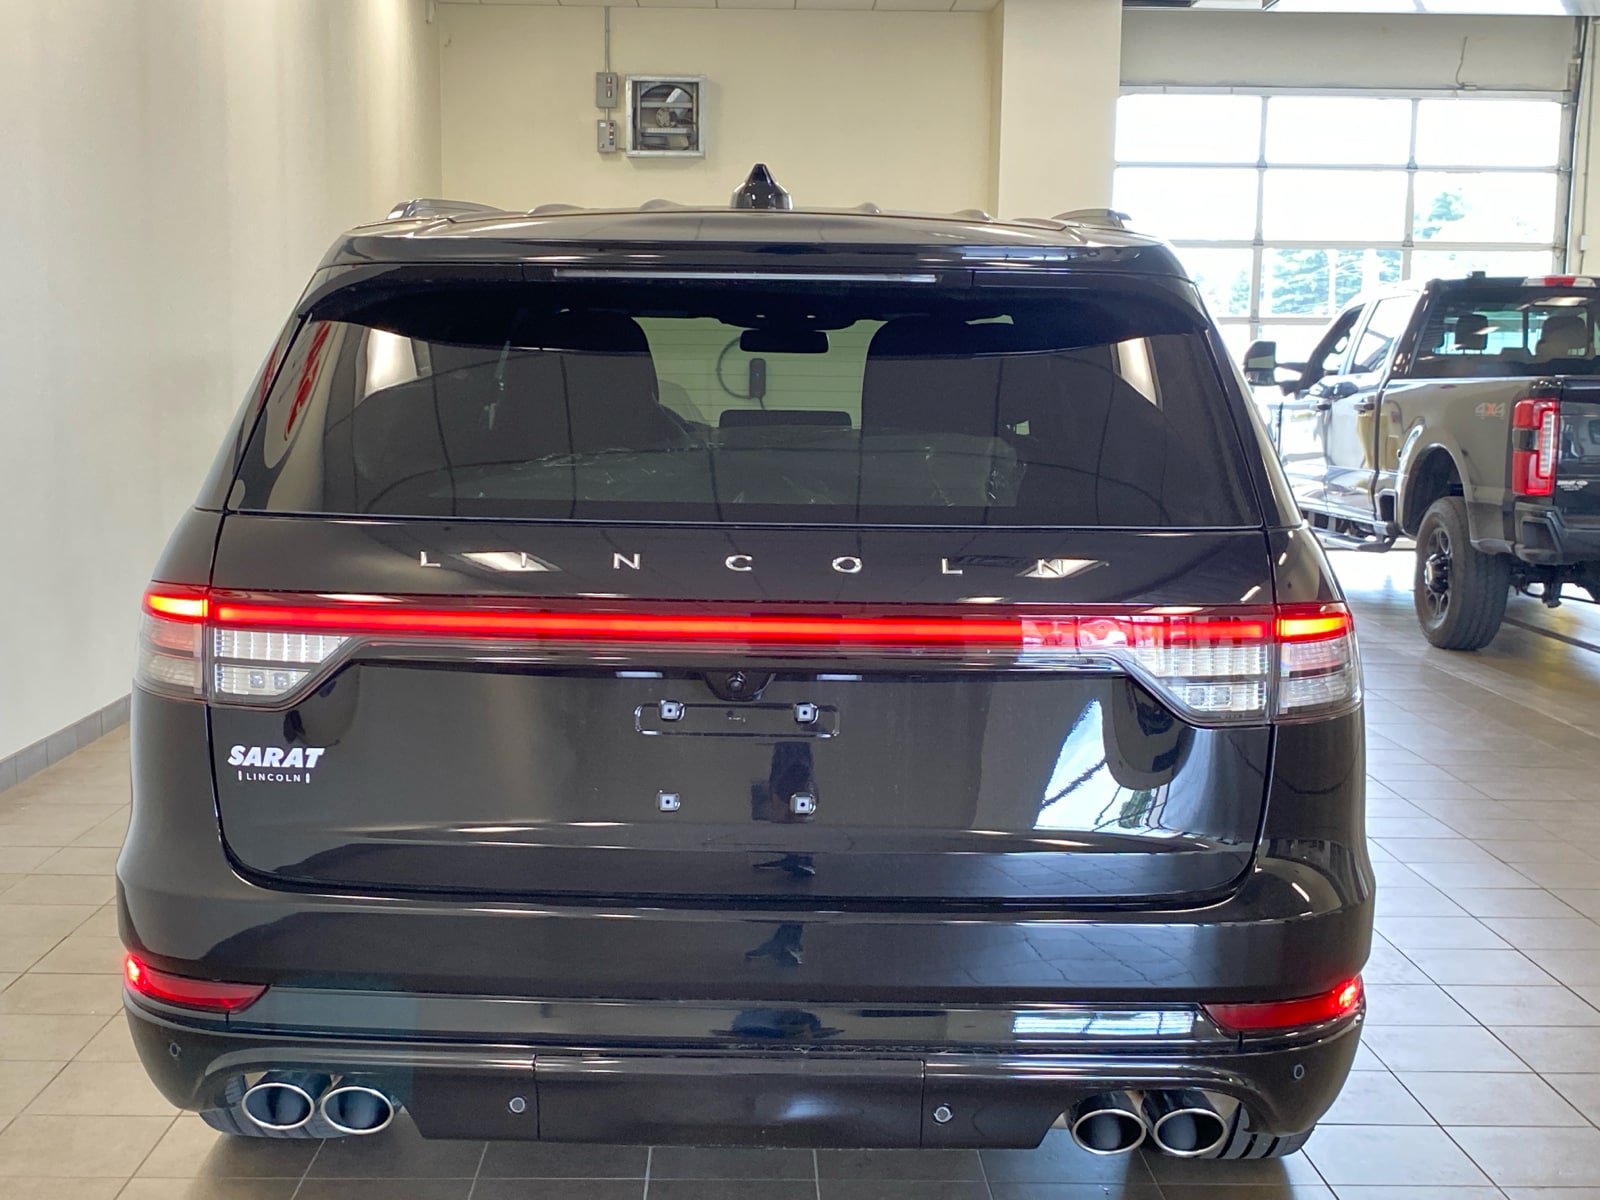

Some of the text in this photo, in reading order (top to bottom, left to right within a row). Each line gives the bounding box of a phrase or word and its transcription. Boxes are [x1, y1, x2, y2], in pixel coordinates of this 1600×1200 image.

[419, 551, 1065, 576] LINCOLN
[227, 745, 325, 768] SARAT
[246, 772, 301, 783] LINCOLN
